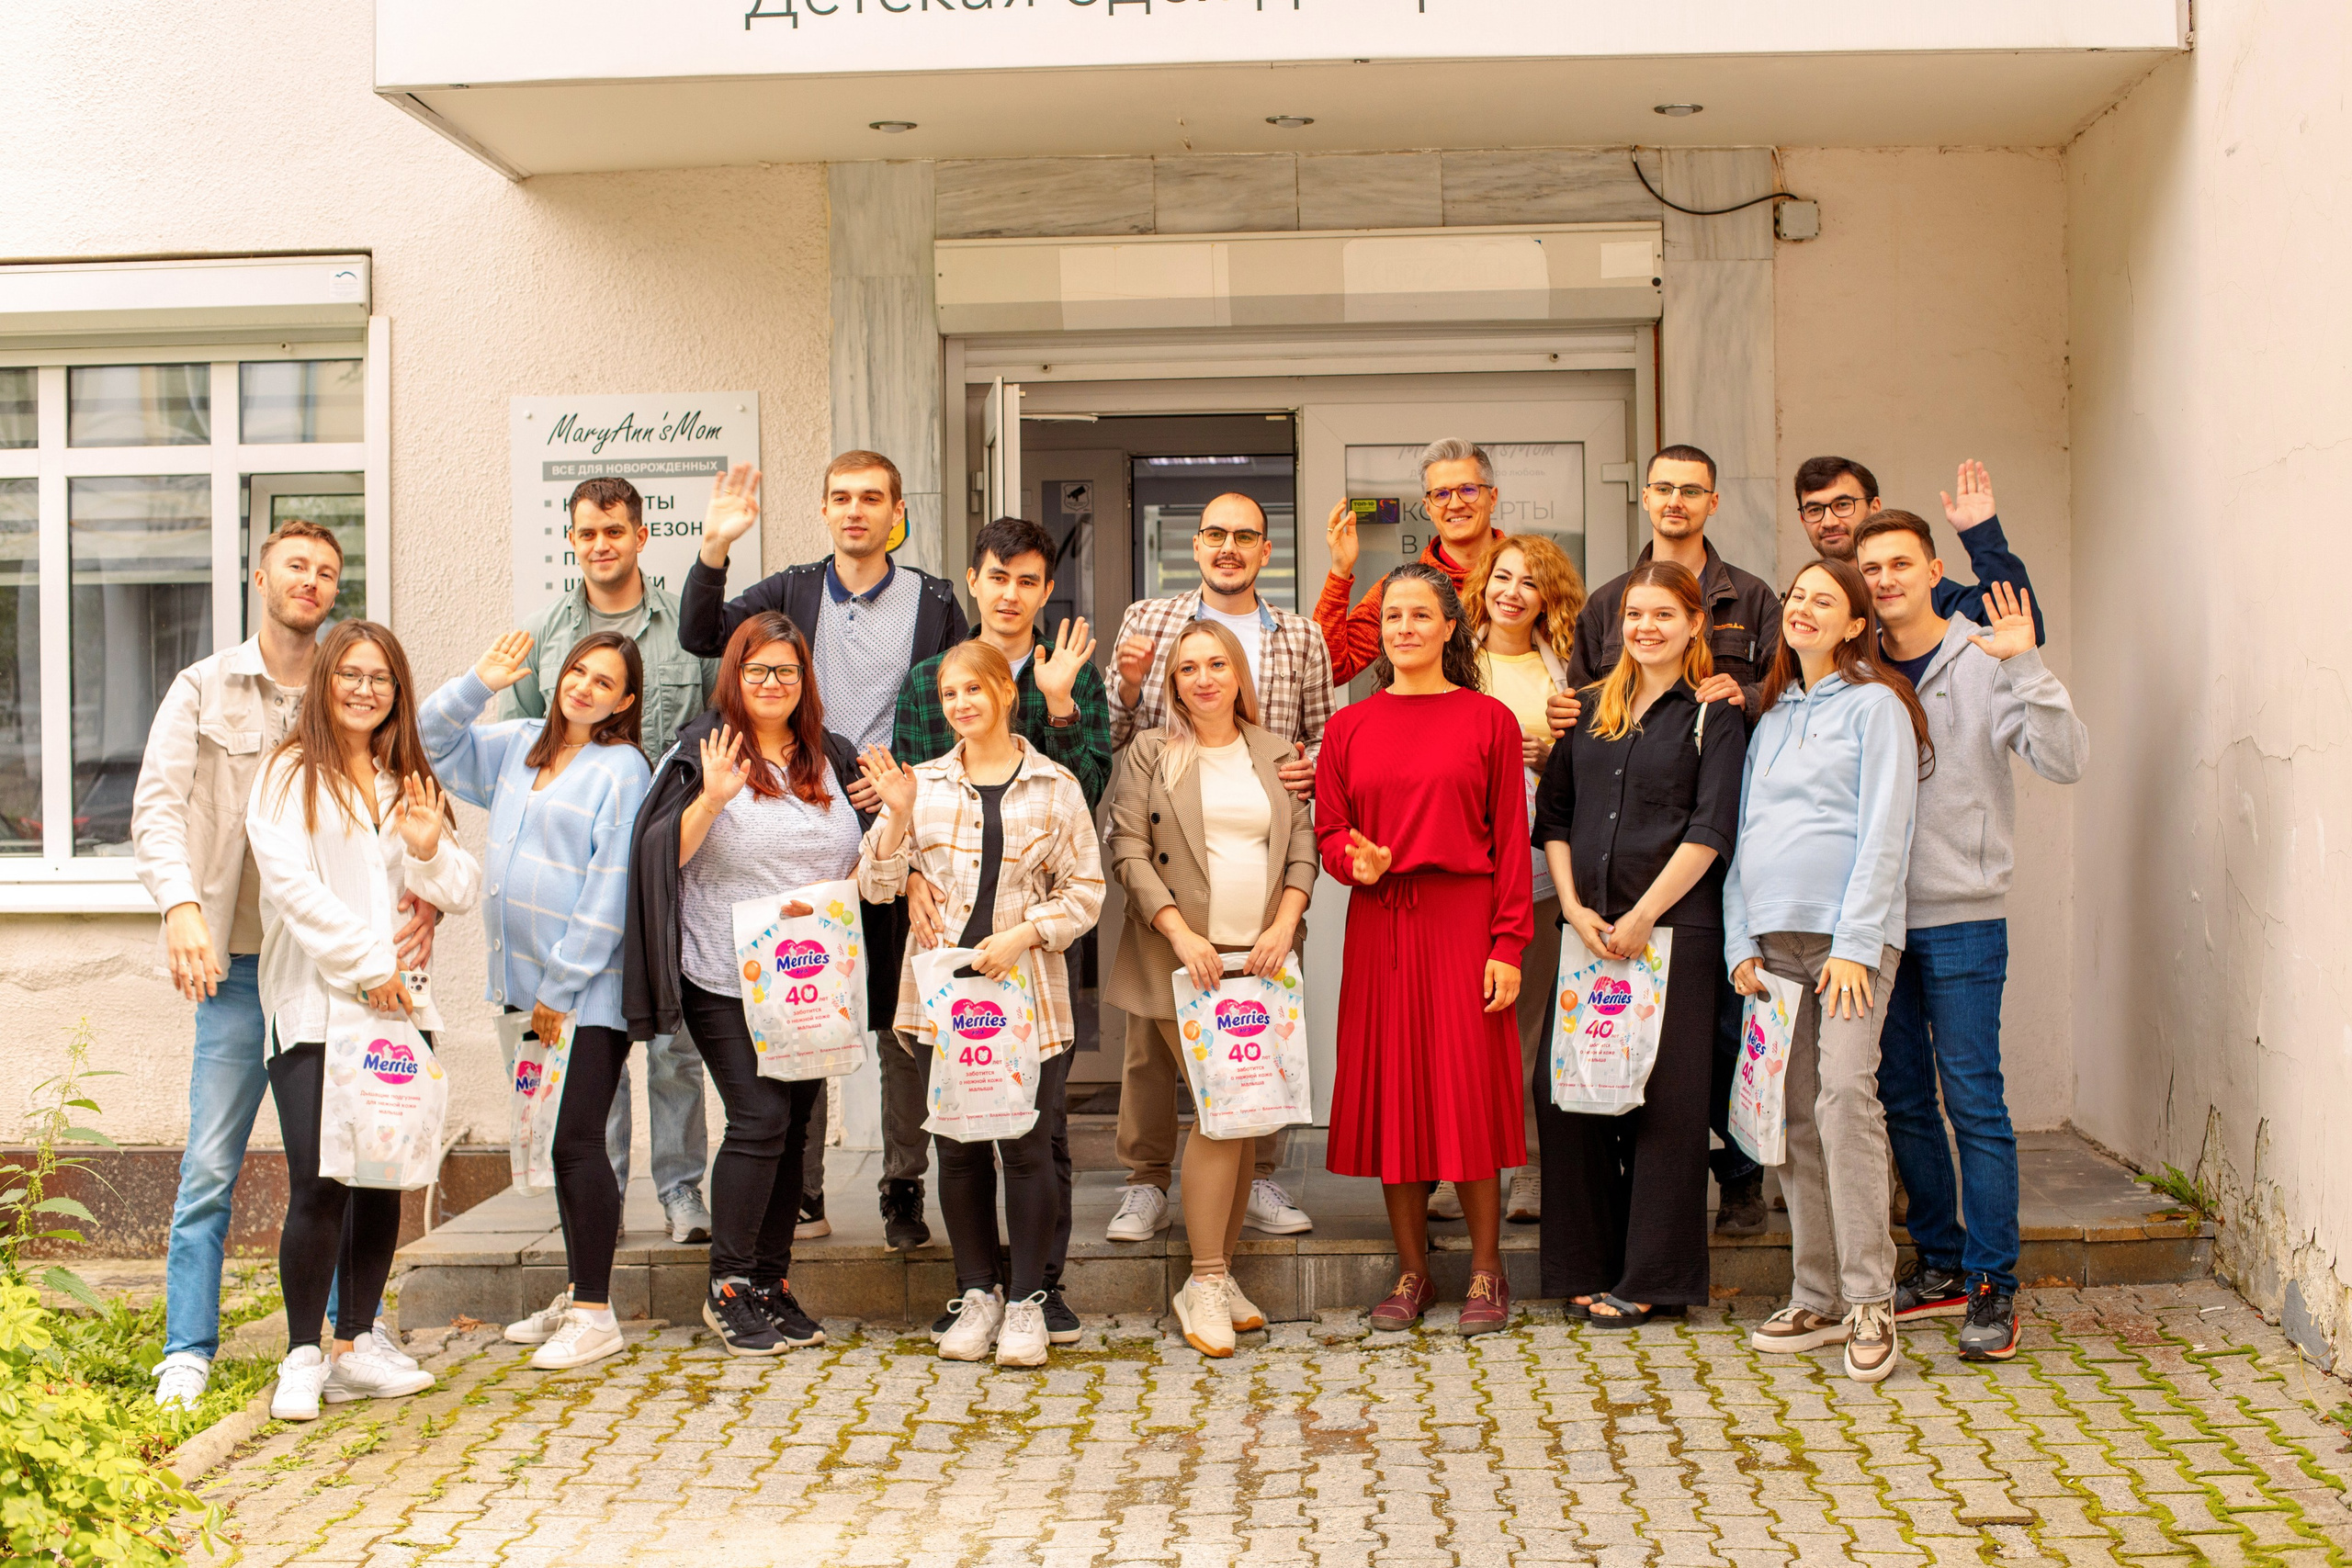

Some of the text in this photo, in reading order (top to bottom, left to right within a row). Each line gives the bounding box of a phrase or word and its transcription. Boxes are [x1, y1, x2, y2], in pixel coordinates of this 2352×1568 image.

[551, 461, 718, 476] ВСЕ ДЛЯ НОВОРОЖДЕННЫХ
[776, 951, 830, 973] Merries
[786, 984, 818, 1005] 40
[1587, 990, 1633, 1004] Merries
[953, 1012, 1007, 1032] Merries
[1217, 1010, 1270, 1030] Merries
[1585, 1020, 1614, 1038] 40
[959, 1045, 992, 1066] 40
[1228, 1042, 1261, 1063] 40
[363, 1054, 418, 1074] Merries
